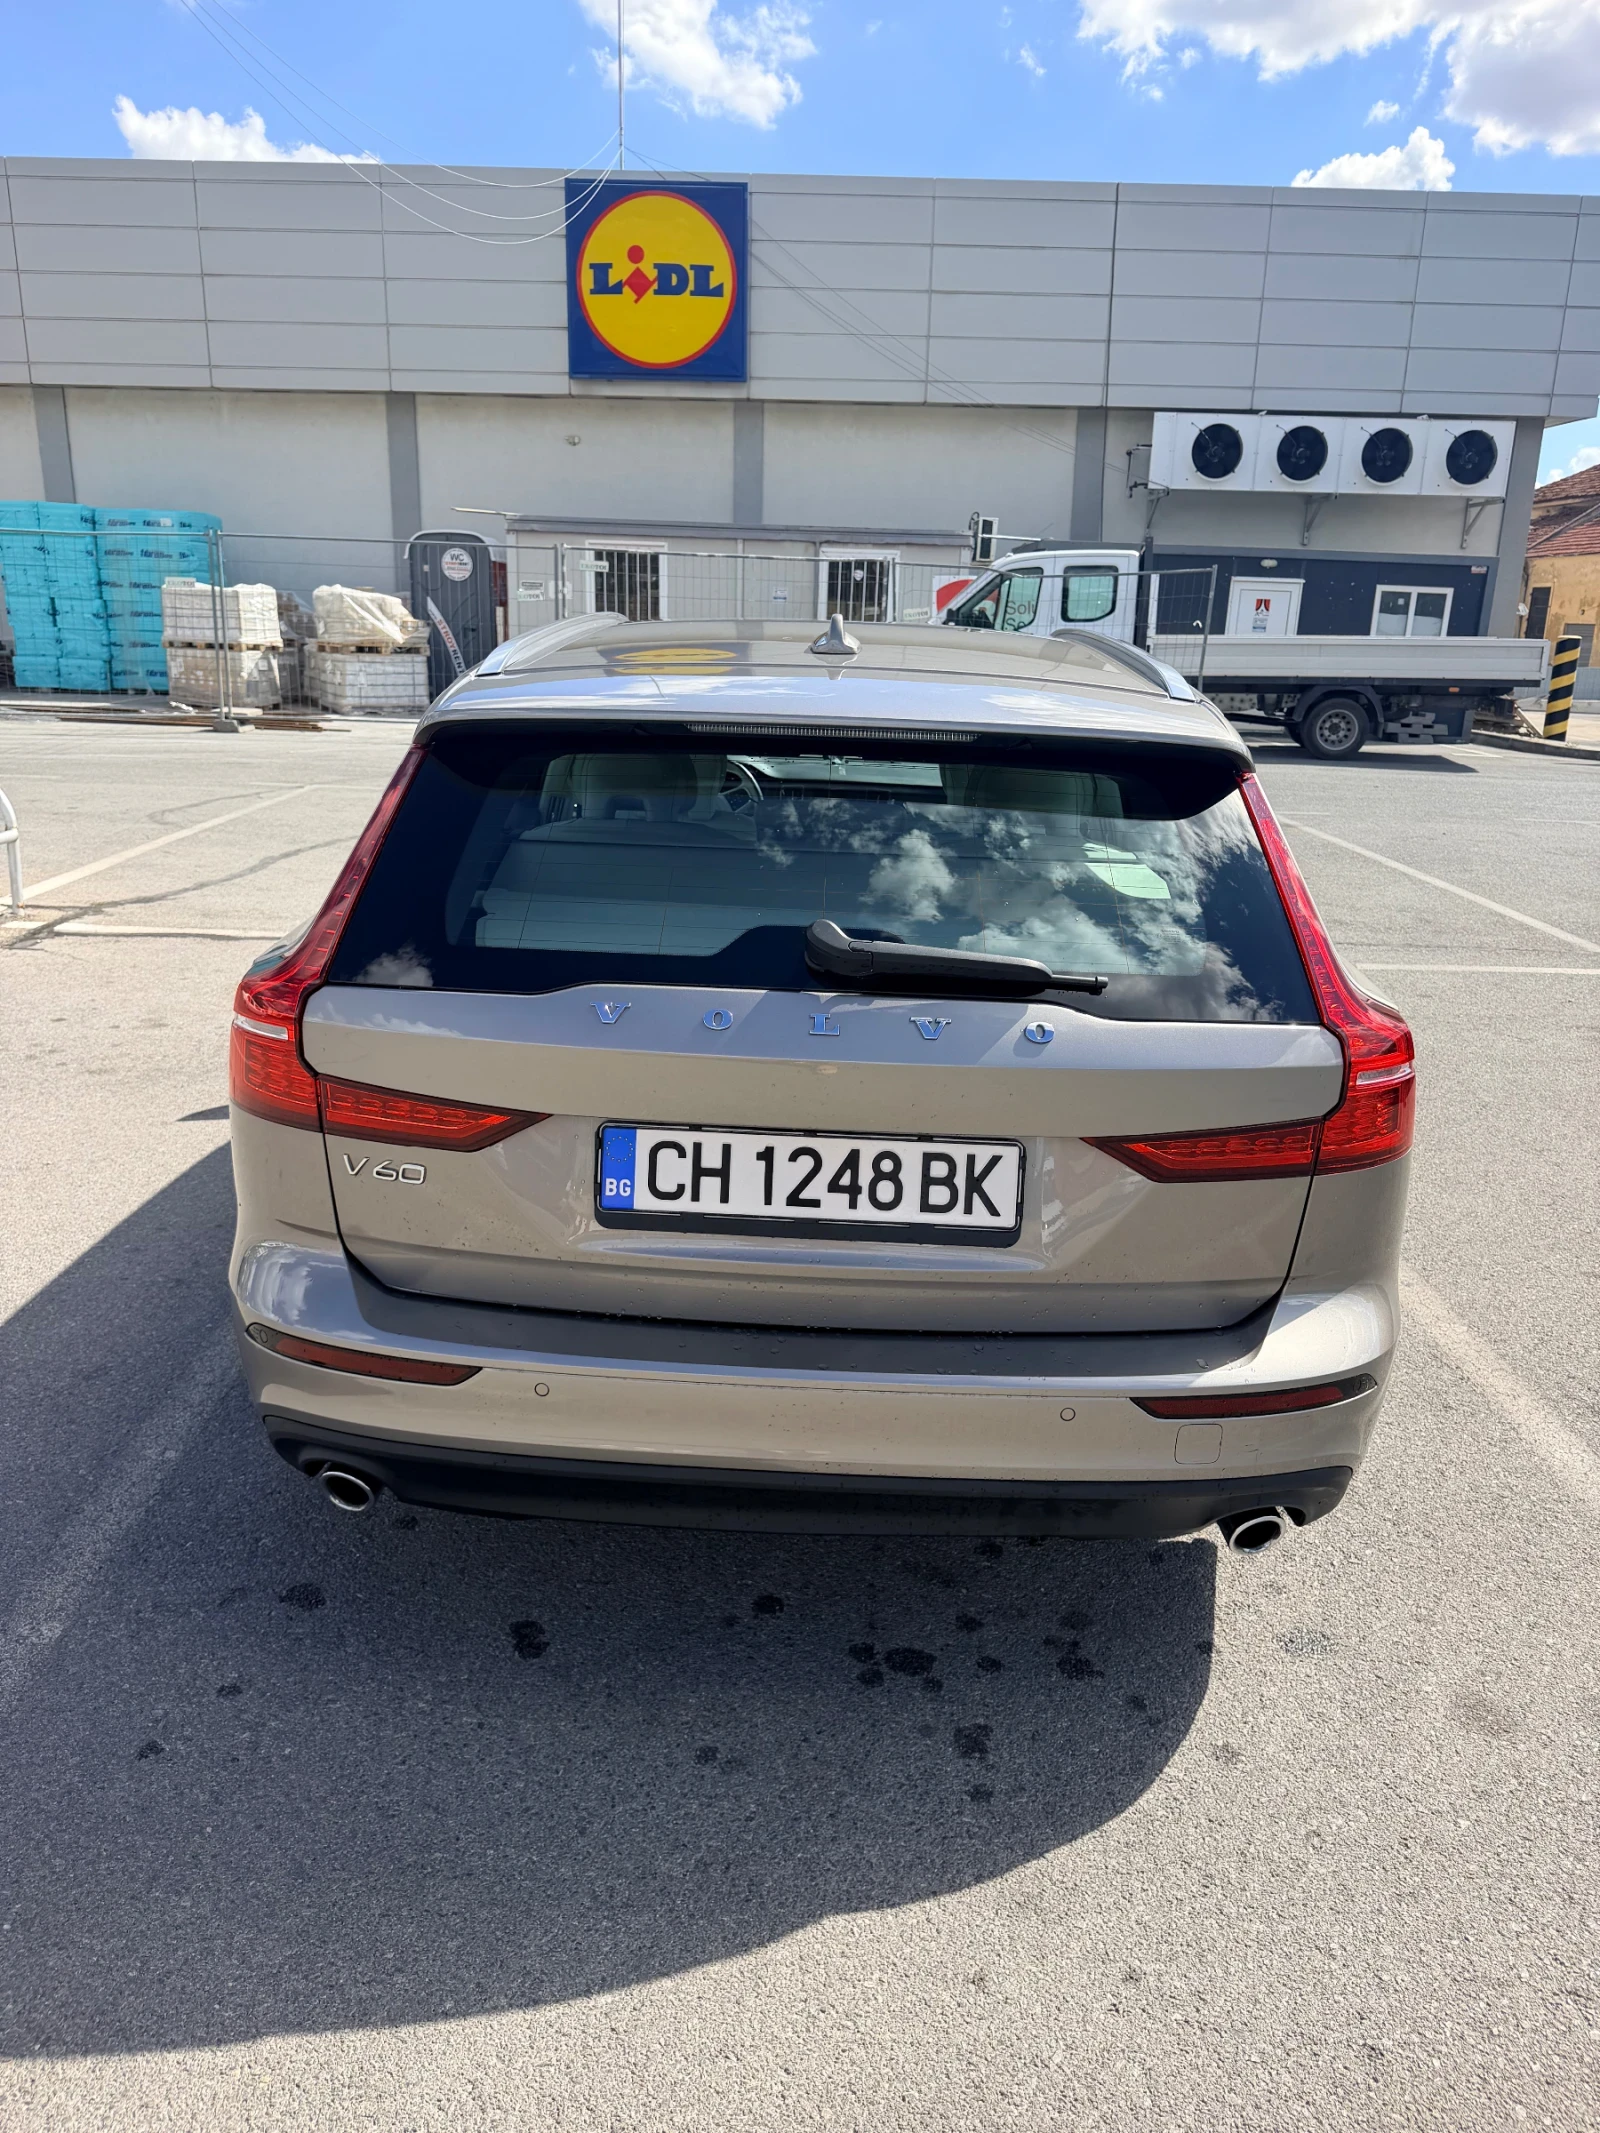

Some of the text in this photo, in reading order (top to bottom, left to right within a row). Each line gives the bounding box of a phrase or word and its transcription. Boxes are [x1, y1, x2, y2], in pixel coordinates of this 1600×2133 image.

[450, 553, 465, 561] WC
[590, 1001, 1056, 1044] VOLVO
[604, 1177, 632, 1197] BG
[647, 1140, 1004, 1218] CH 1248 BK
